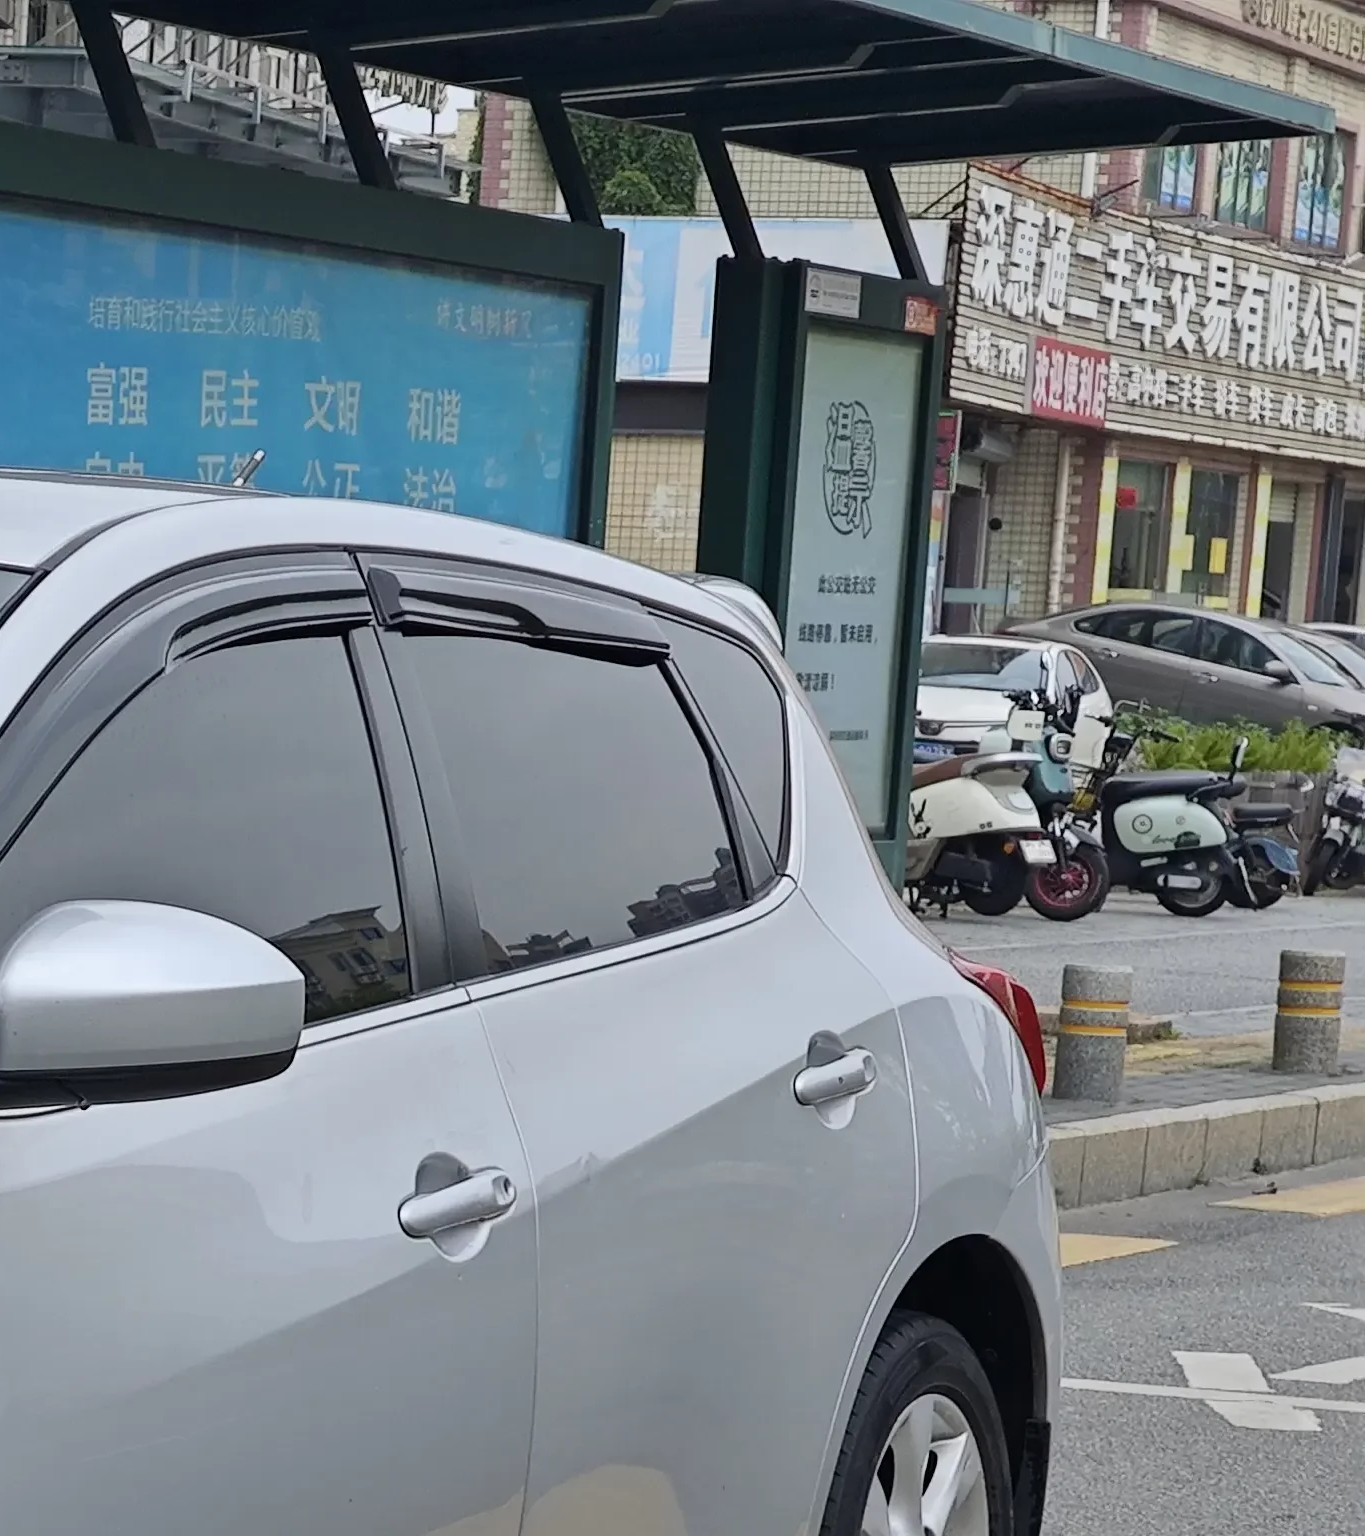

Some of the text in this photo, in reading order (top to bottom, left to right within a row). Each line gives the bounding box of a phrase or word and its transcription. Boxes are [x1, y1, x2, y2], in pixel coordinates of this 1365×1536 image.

[86, 362, 149, 427] 富强
[200, 369, 261, 429] 民主
[303, 376, 362, 436] 文明
[1032, 345, 1108, 420] 欢迎便利店
[406, 387, 462, 446] 和谐
[403, 466, 457, 514] 法治
